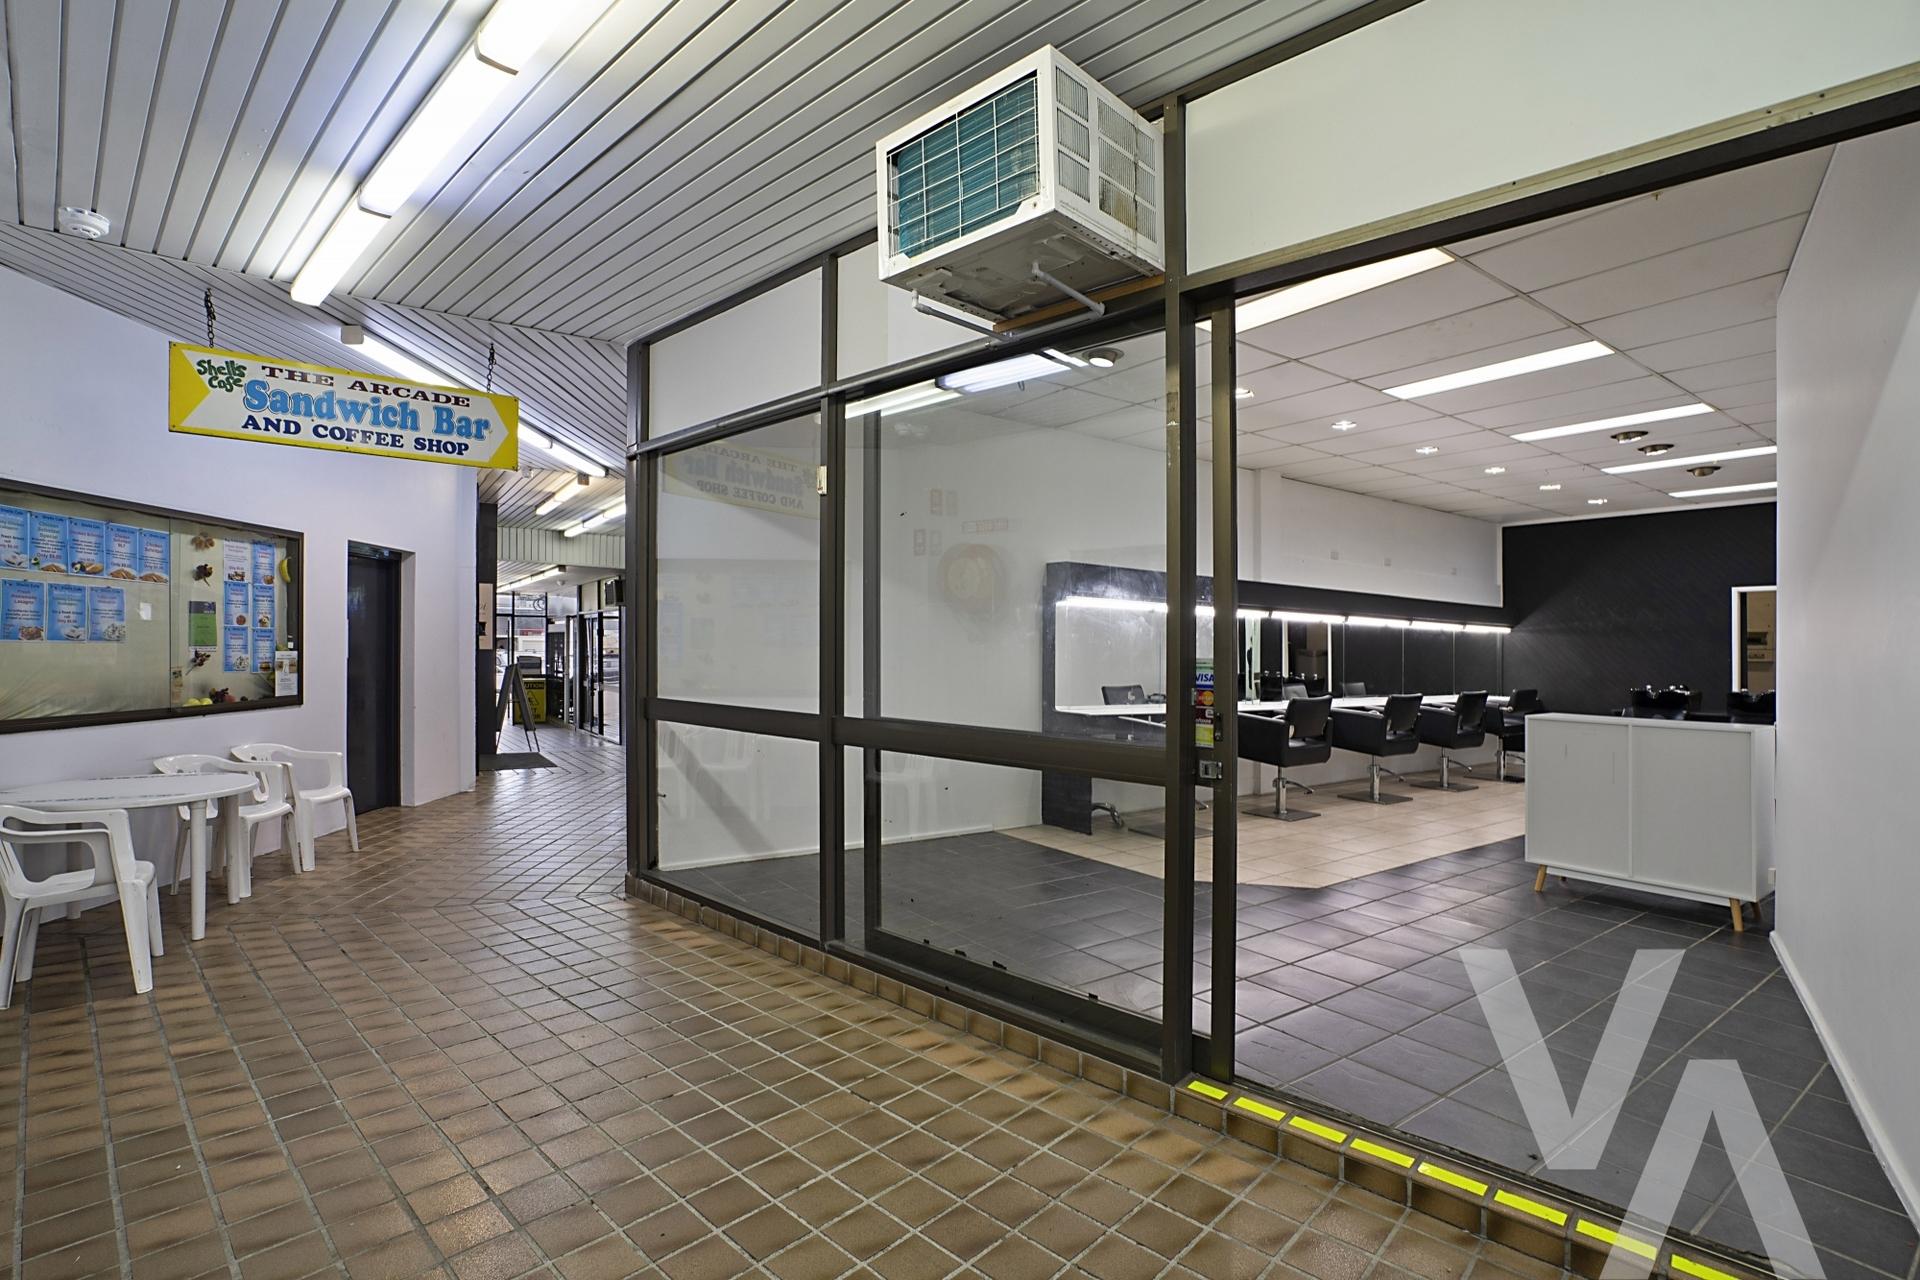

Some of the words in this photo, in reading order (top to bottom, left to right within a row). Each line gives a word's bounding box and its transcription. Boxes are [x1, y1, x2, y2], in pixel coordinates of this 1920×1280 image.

[261, 365, 334, 387] THE
[347, 380, 470, 407] ARCADE
[243, 378, 420, 433] Sandwich
[432, 404, 491, 441] Bar
[241, 414, 302, 436] AND
[312, 424, 404, 449] COFFEE
[413, 437, 469, 456] SHOP
